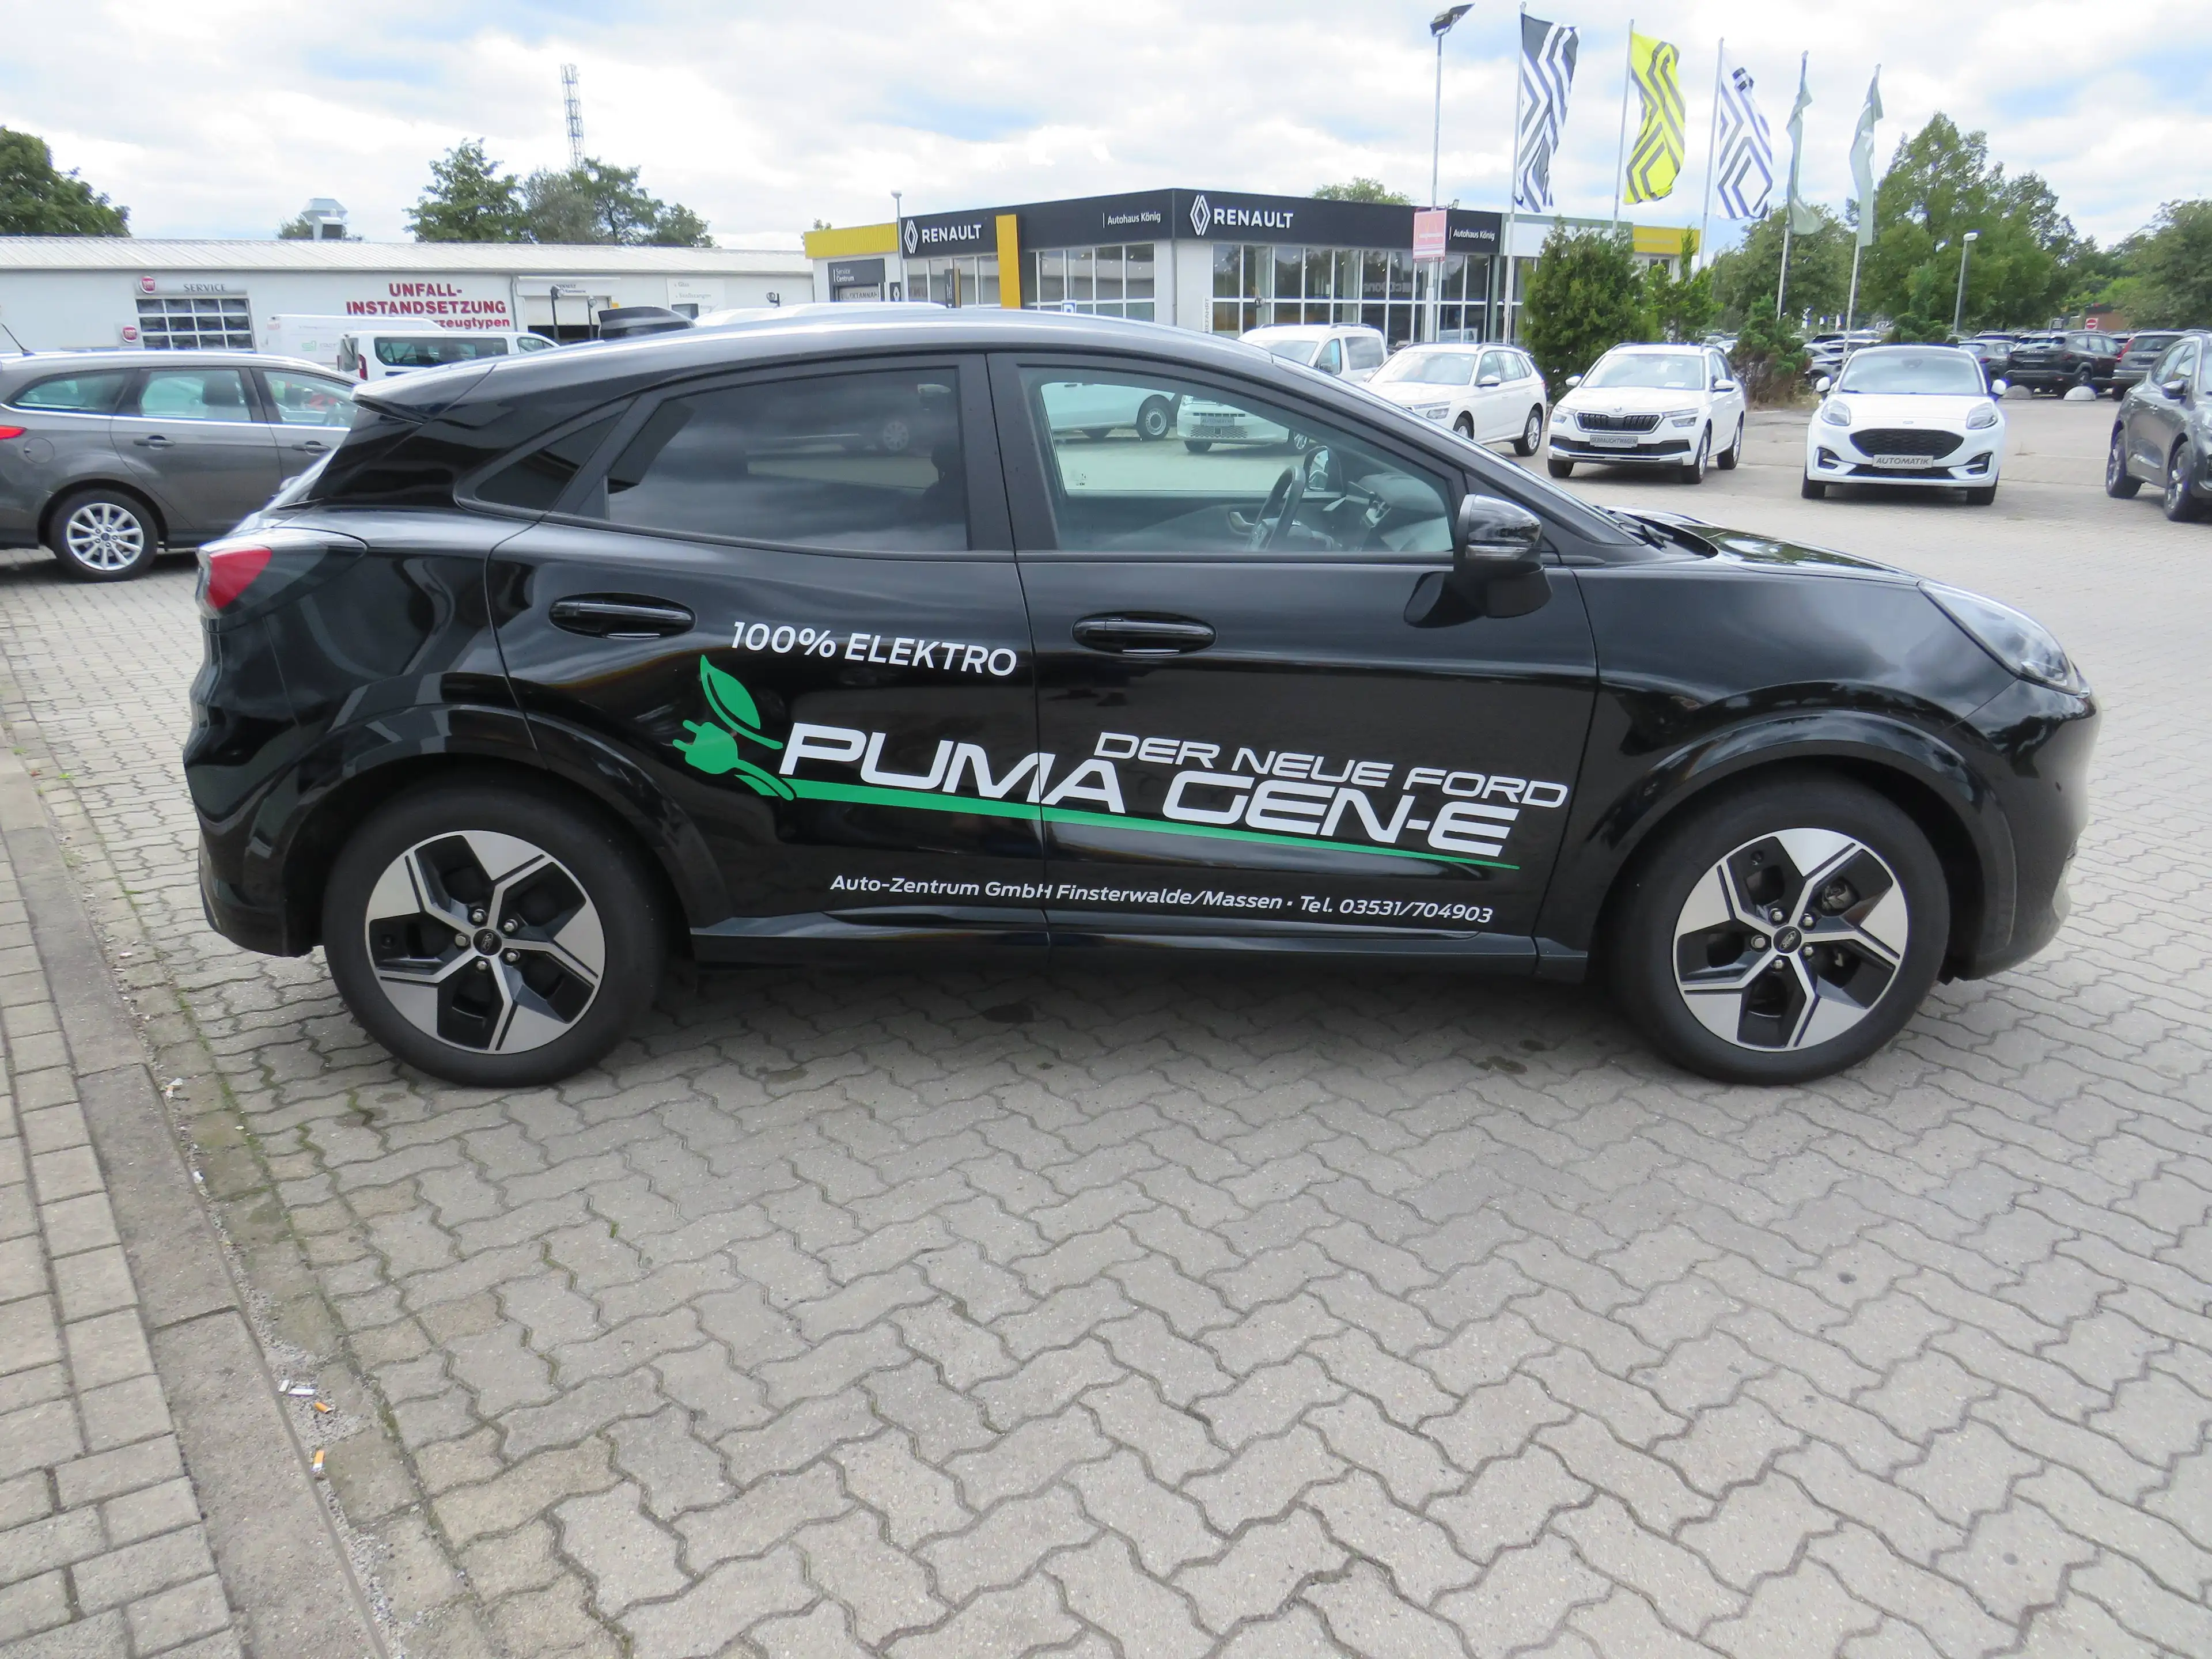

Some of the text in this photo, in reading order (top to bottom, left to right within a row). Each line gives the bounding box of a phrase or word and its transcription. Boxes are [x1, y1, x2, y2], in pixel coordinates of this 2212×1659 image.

[1107, 212, 1161, 225] Autohaus König
[1213, 208, 1294, 228] RENAULT
[922, 224, 982, 243] RENAULT
[1453, 229, 1479, 238] Autohaus
[1480, 230, 1495, 242] König
[183, 283, 226, 291] SERVICE
[388, 283, 463, 297] UNFALL-
[346, 301, 506, 315] INSTANDSETZUNG
[732, 621, 1017, 676] 100% ELEKTRO
[1094, 732, 1568, 808] DER NEUE FORD
[779, 722, 1520, 857] PUMA GEN-E
[830, 875, 1493, 923] Auto-Zentrum GmbH Finsterwalde/Massen Tel. 03531/704903
